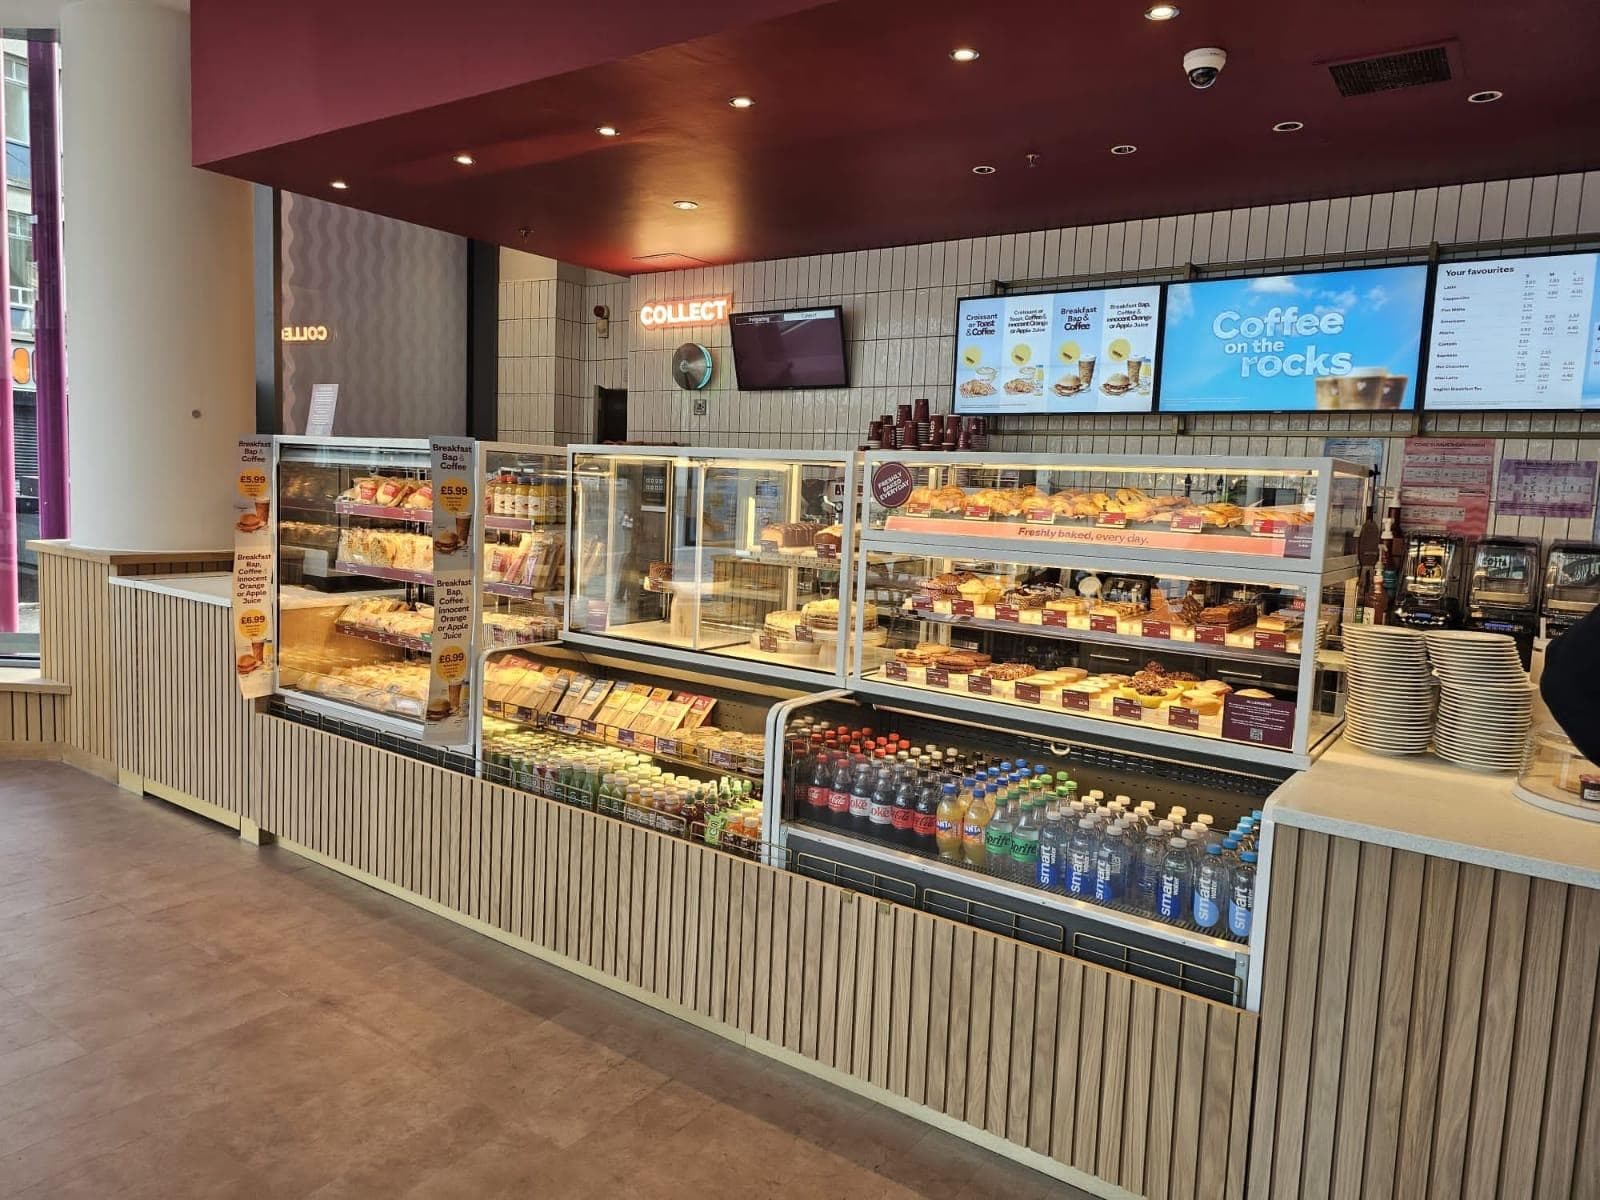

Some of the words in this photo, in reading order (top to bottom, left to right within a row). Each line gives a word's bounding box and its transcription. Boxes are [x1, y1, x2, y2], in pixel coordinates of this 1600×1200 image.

[1446, 269, 1466, 277] Your
[1467, 266, 1514, 276] favourites
[639, 300, 728, 326] COLLECT
[1061, 306, 1097, 315] Breakfast
[966, 313, 998, 321] Croissant
[1068, 315, 1082, 323] Bap
[1083, 313, 1090, 321] &
[976, 320, 996, 328] Toast
[1063, 322, 1090, 331] Coffee
[1115, 322, 1133, 330] Apple
[1213, 306, 1345, 339] Coffee
[966, 328, 972, 337] &
[972, 327, 996, 336] Coffee
[1225, 341, 1248, 354] on
[1252, 337, 1285, 353] the
[1241, 345, 1354, 378] rocks
[433, 443, 472, 453] Breakfast
[442, 453, 458, 462] Bap
[440, 462, 467, 471] Coffee
[240, 475, 266, 484] £5.99
[878, 472, 902, 489] FRESHLY
[879, 480, 909, 501] EVERYDAY
[882, 478, 902, 493] BAKED
[441, 486, 468, 496] £5.99
[1018, 527, 1057, 540] Freshly
[1058, 527, 1093, 541] baked,
[1095, 532, 1126, 543] every
[1127, 533, 1149, 545] day.
[237, 553, 271, 561] Breakfast
[436, 580, 472, 588] Breakfast
[246, 589, 267, 597] Apple
[446, 588, 463, 597] Bap,
[438, 605, 469, 614] innocent
[240, 615, 265, 625] £6.99
[440, 614, 467, 623] Orange
[446, 622, 468, 632] Apple
[442, 632, 462, 640] Juice
[439, 652, 464, 664] £6.99
[1040, 844, 1051, 885] smart
[1070, 852, 1084, 893] smart
[1096, 859, 1107, 901] smart
[1161, 873, 1173, 917] smart
[1199, 876, 1211, 921] smart
[1234, 885, 1248, 930] smart
